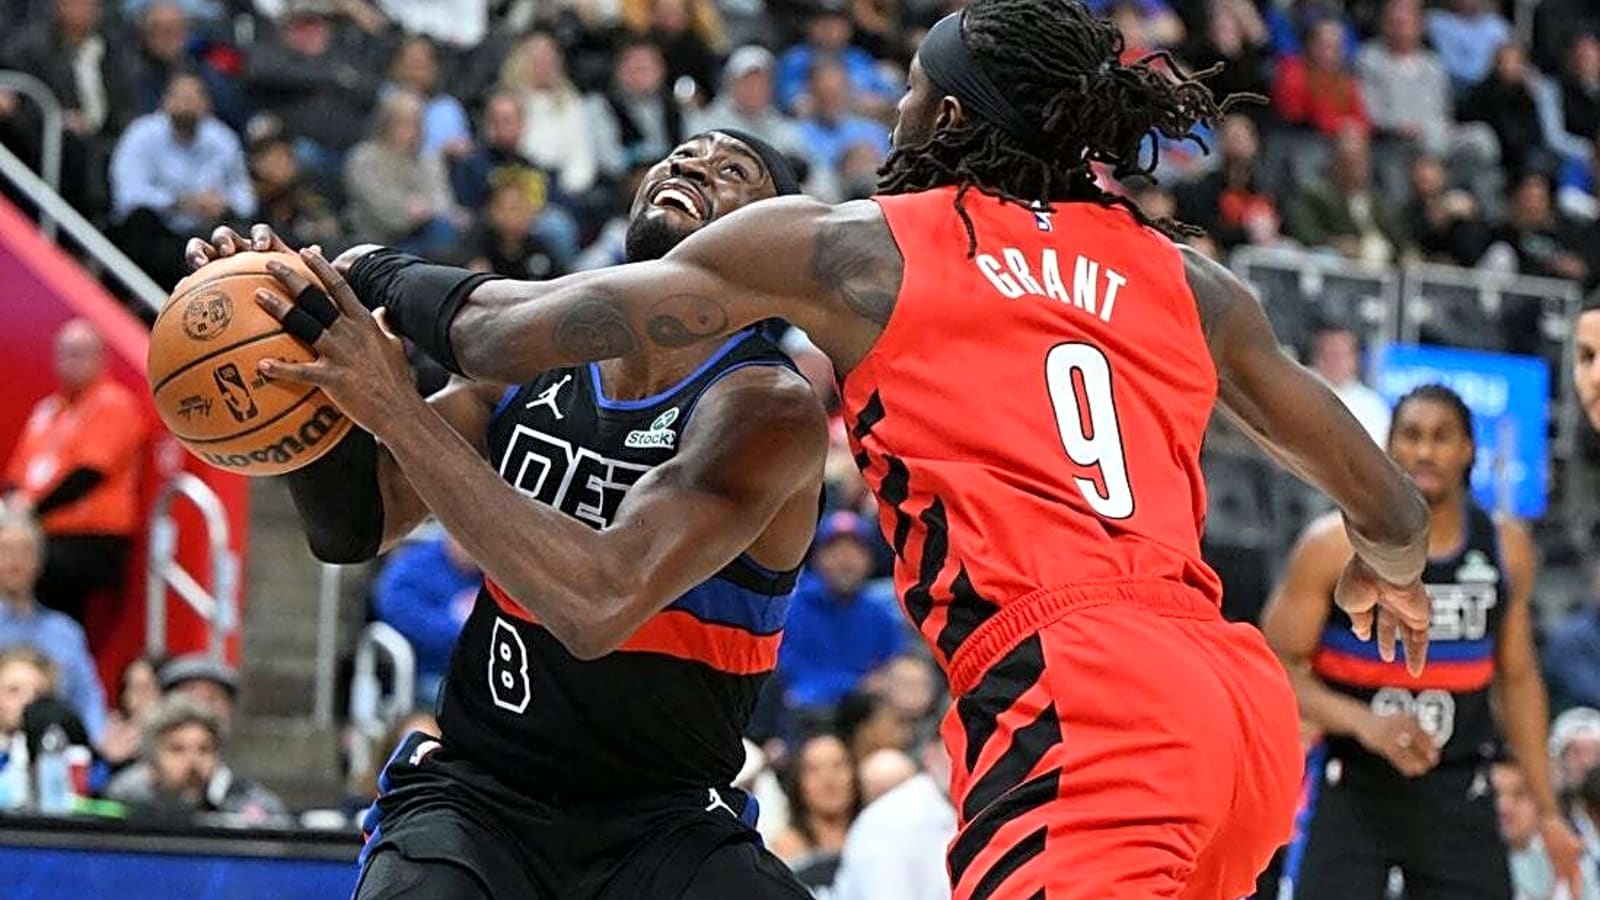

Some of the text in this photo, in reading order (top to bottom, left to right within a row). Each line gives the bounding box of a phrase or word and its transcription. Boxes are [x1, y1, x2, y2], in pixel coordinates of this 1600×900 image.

[976, 248, 1126, 322] GRANT
[201, 404, 343, 467] Wilson
[1045, 341, 1135, 520] 9
[1396, 583, 1498, 640] ET
[488, 616, 531, 714] 8
